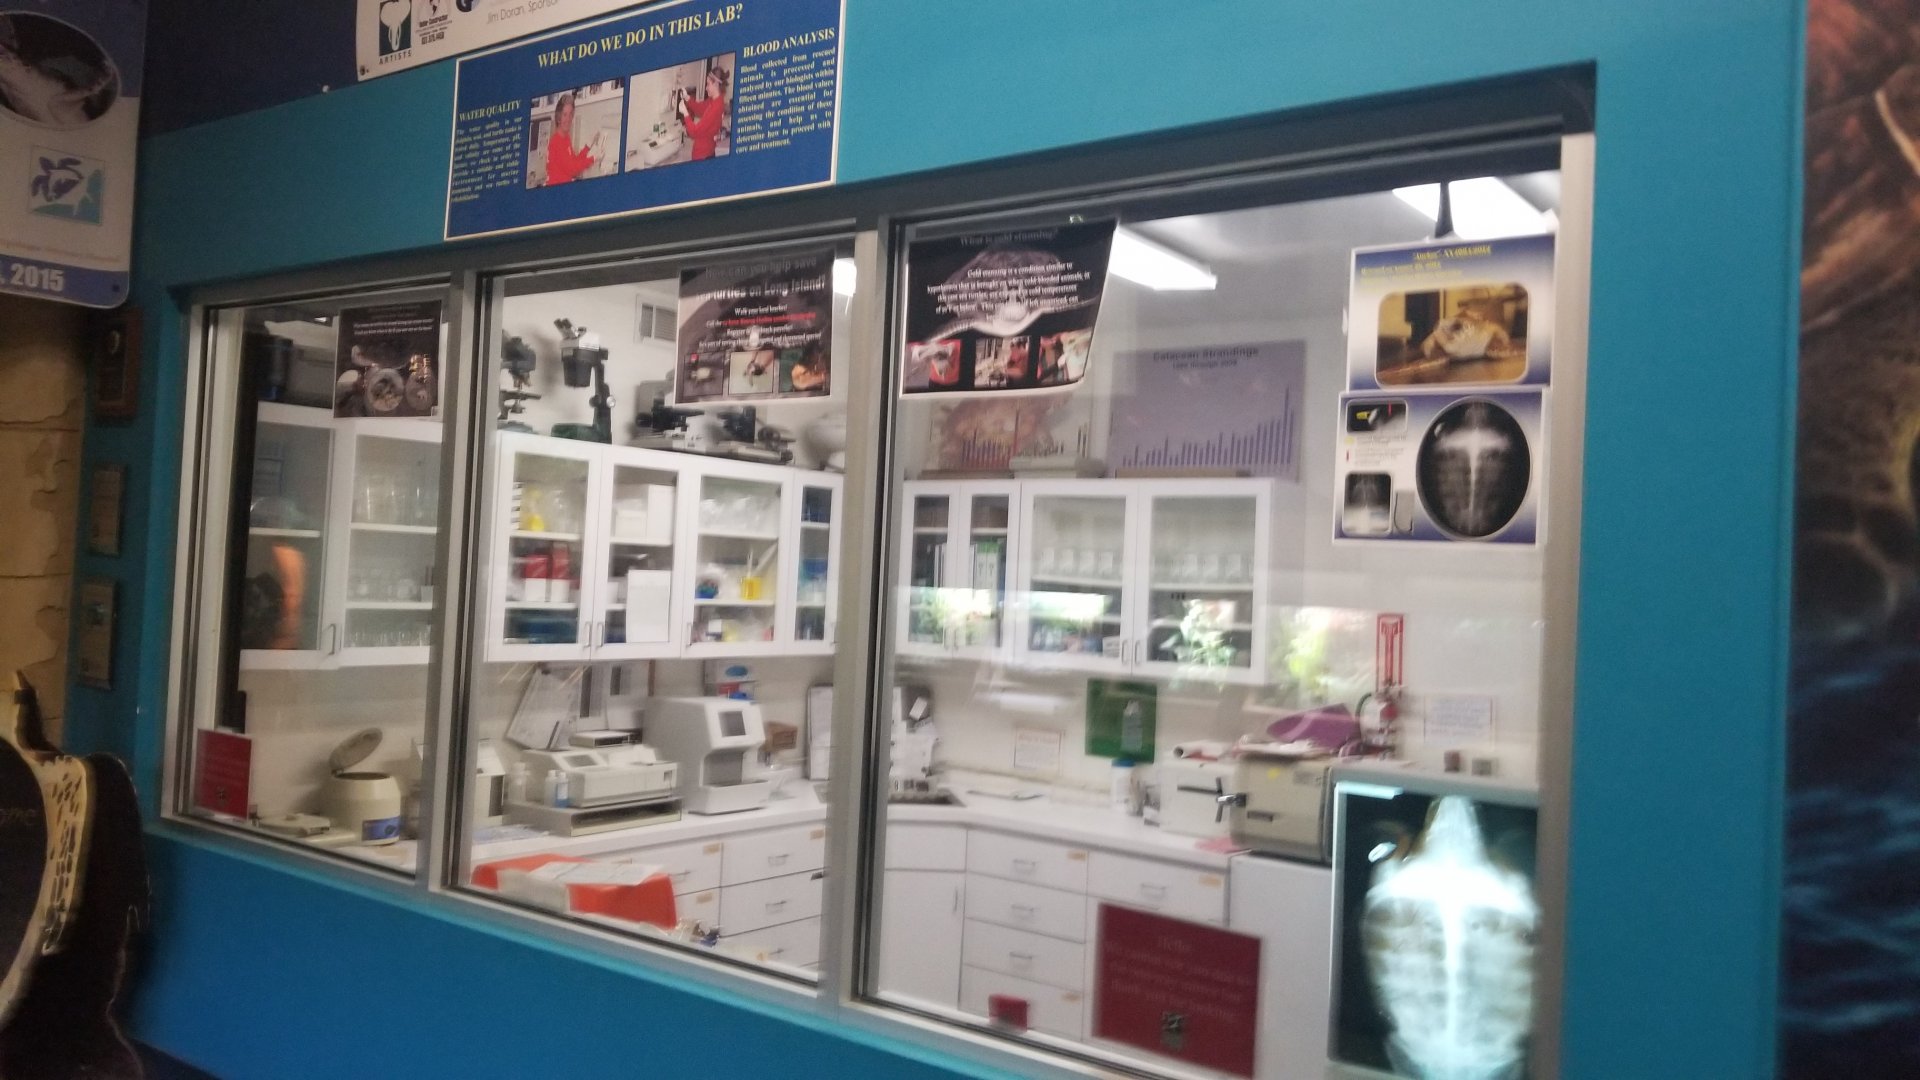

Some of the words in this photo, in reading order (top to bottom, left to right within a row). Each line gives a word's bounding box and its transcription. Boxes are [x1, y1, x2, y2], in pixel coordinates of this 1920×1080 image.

[538, 47, 576, 68] WHAT
[578, 41, 598, 58] DO
[601, 35, 622, 52] WE
[625, 28, 646, 47] DO
[650, 23, 664, 41] IN
[668, 14, 701, 35] THIS
[705, 3, 744, 27] LAB?
[743, 39, 780, 58] BLOOD
[782, 27, 836, 51] ANALYSIS
[379, 50, 411, 64] ARTISTS
[792, 54, 807, 63] from
[822, 57, 835, 67] and
[766, 80, 773, 90] by
[784, 86, 796, 95] The
[459, 109, 485, 122] WATER
[486, 99, 521, 117] QUALITY
[807, 103, 815, 111] of
[769, 118, 782, 128] and
[748, 142, 760, 151] and
[11, 263, 64, 291] 2015
